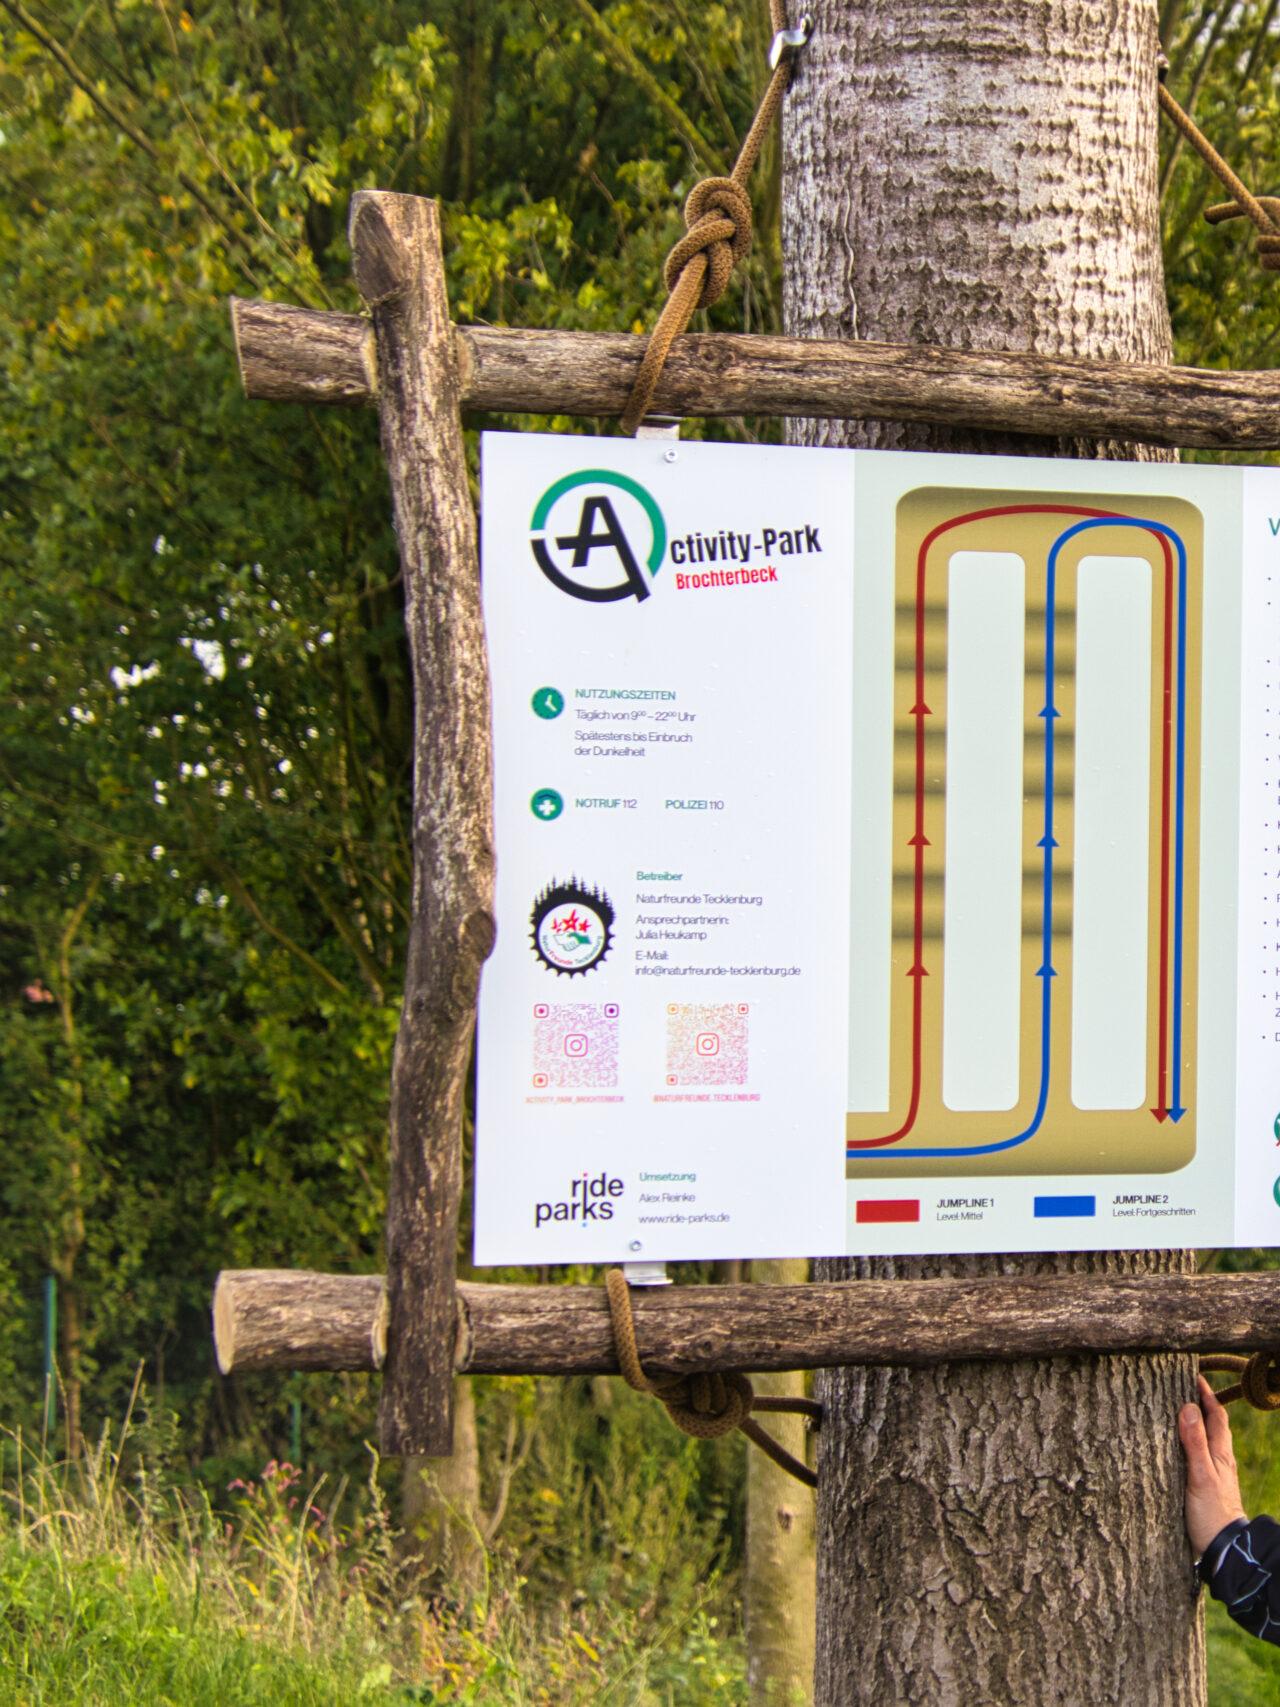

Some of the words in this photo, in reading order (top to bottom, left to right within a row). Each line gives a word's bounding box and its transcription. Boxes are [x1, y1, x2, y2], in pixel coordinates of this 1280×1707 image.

[676, 566, 778, 589] Brochterbeck
[575, 689, 676, 700] NUTZUNGSZEITEN
[575, 709, 610, 721] Täglich
[678, 712, 696, 721] Uhr
[575, 730, 631, 742] Spätestens
[633, 732, 646, 741] bis
[649, 732, 693, 742] Einbruch
[575, 747, 591, 755] der
[593, 747, 645, 756] Dunkelheit
[576, 799, 621, 808] NOTRUF
[623, 799, 637, 808] 112
[665, 800, 707, 809] POLIZEI
[709, 801, 724, 810] 110
[637, 871, 683, 880] Betreiber
[636, 894, 701, 904] Naturfreunde
[703, 894, 763, 906] Tecklenburg
[636, 930, 658, 940] Julia
[660, 930, 707, 941] Heukamp
[639, 1172, 696, 1182] Umsetzung
[572, 1172, 624, 1197] ride
[639, 1194, 660, 1202] Alex
[662, 1192, 695, 1202] Reinke
[1113, 1195, 1161, 1205] JUMPLINE
[937, 1198, 987, 1208] JUMPLINE
[536, 1201, 614, 1228] parks
[961, 1211, 983, 1220] Mittel
[1137, 1207, 1195, 1217] Fortgeschritten
[639, 1214, 730, 1224] www.ride-parks.de
